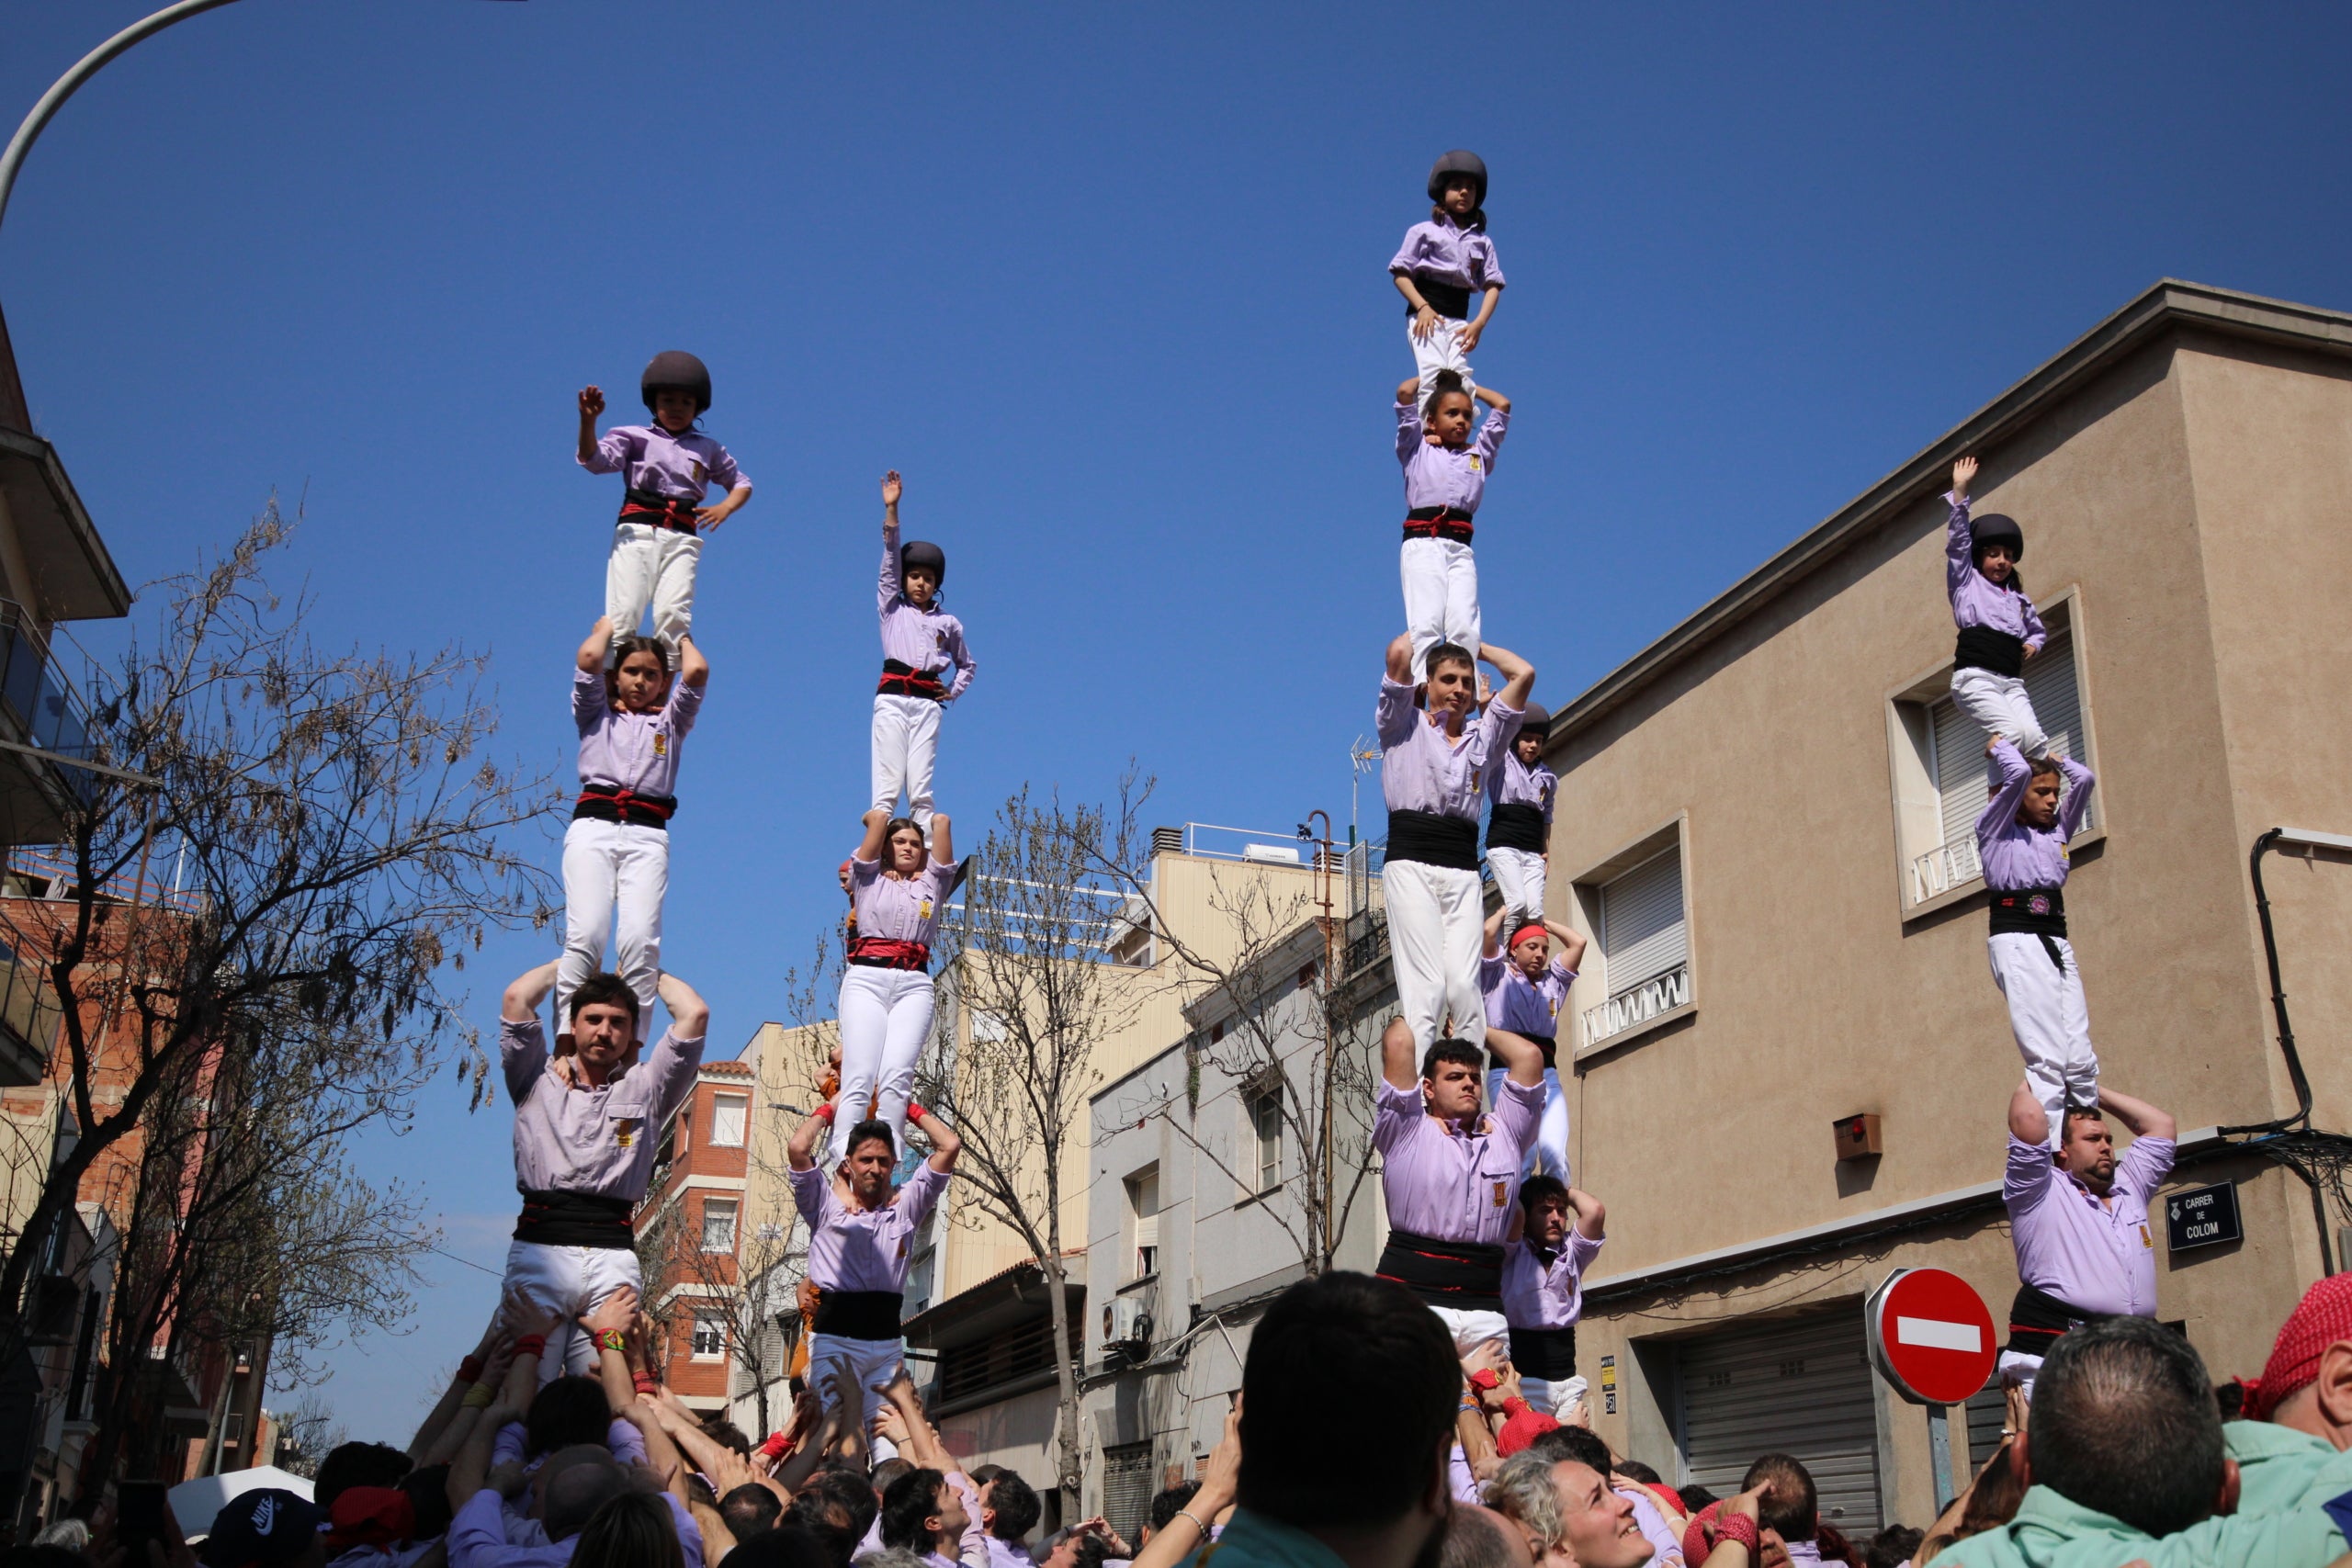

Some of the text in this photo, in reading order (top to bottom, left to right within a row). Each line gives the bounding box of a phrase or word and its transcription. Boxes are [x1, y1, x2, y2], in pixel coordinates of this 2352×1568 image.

[2185, 1194, 2214, 1210] CARRER
[2196, 1211, 2205, 1221] DE
[2186, 1222, 2219, 1239] COLOM
[251, 1497, 271, 1528] NIKE
